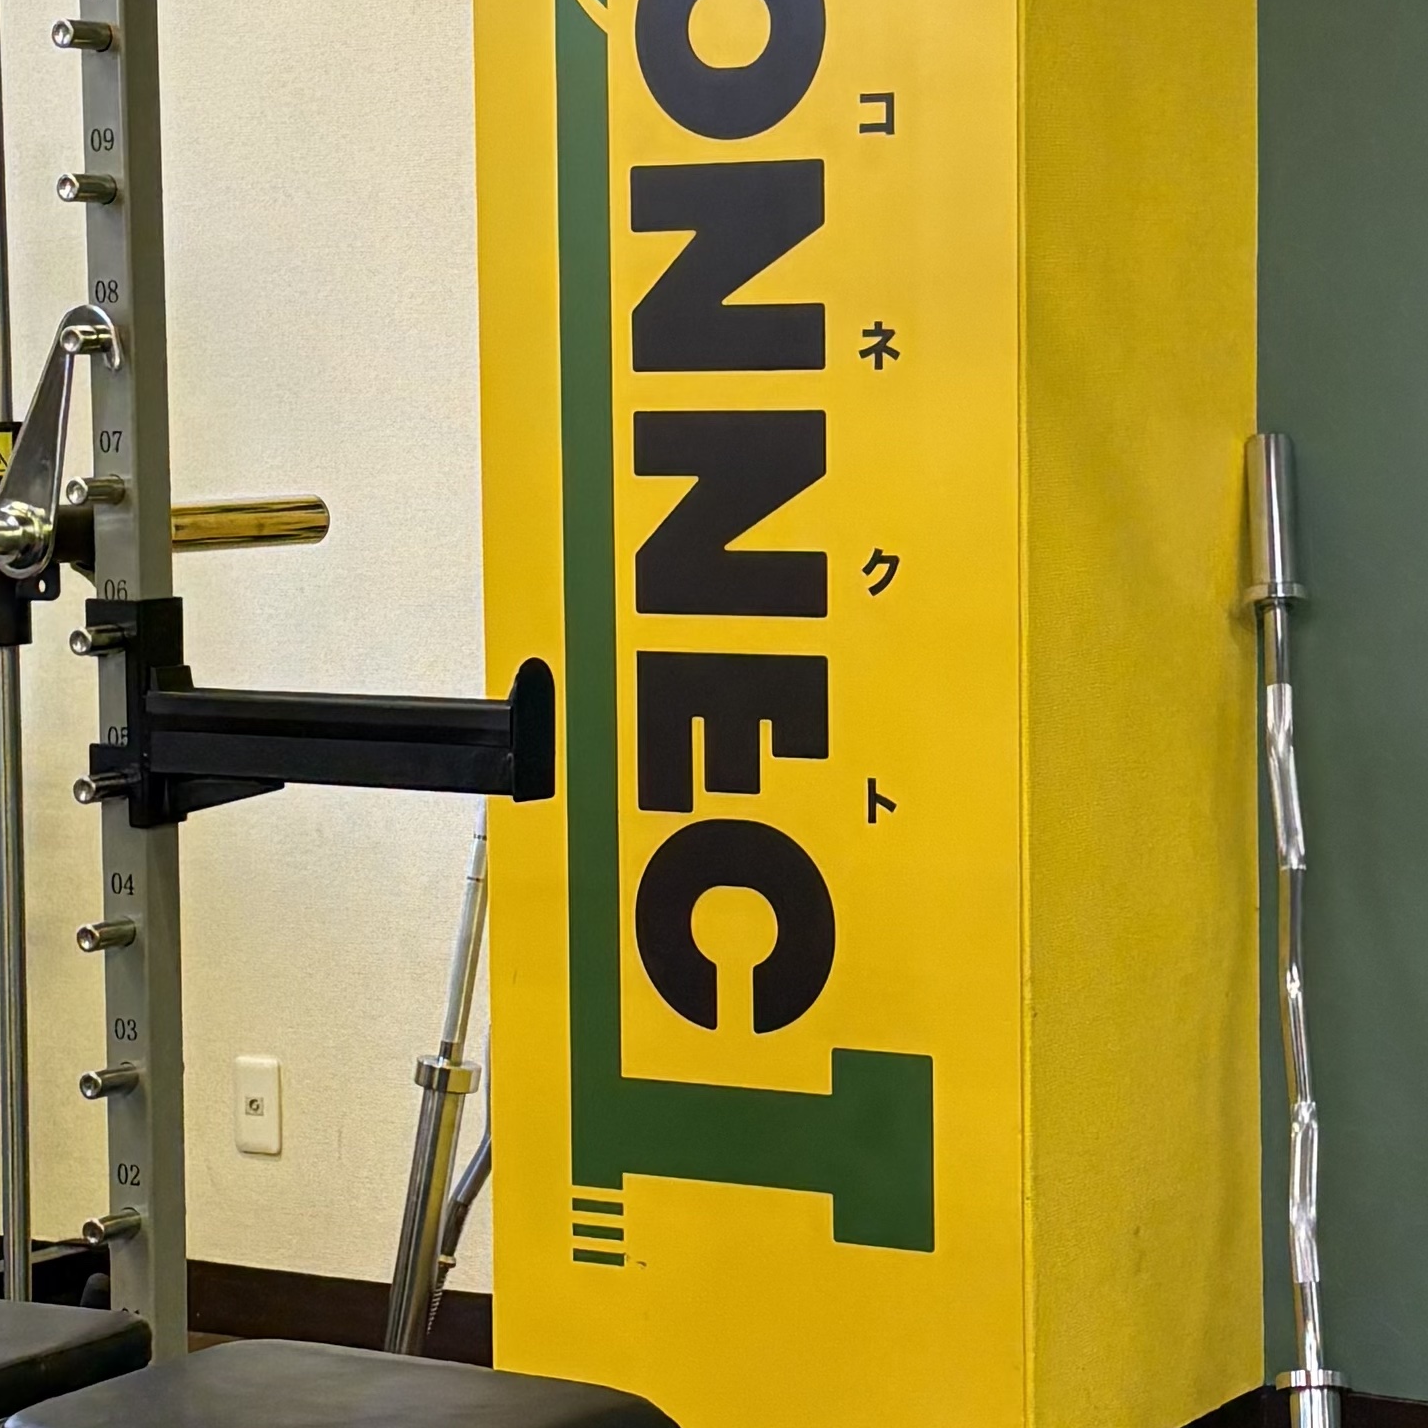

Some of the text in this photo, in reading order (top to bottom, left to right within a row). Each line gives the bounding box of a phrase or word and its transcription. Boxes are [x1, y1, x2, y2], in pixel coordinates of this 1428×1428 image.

[90, 127, 115, 153] 09
[94, 279, 119, 304] 08
[99, 430, 123, 454] 07
[858, 92, 901, 824] コネクト
[104, 579, 128, 601] 06
[110, 872, 135, 896] 04
[114, 1018, 138, 1041] 03
[117, 1163, 141, 1187] 02
